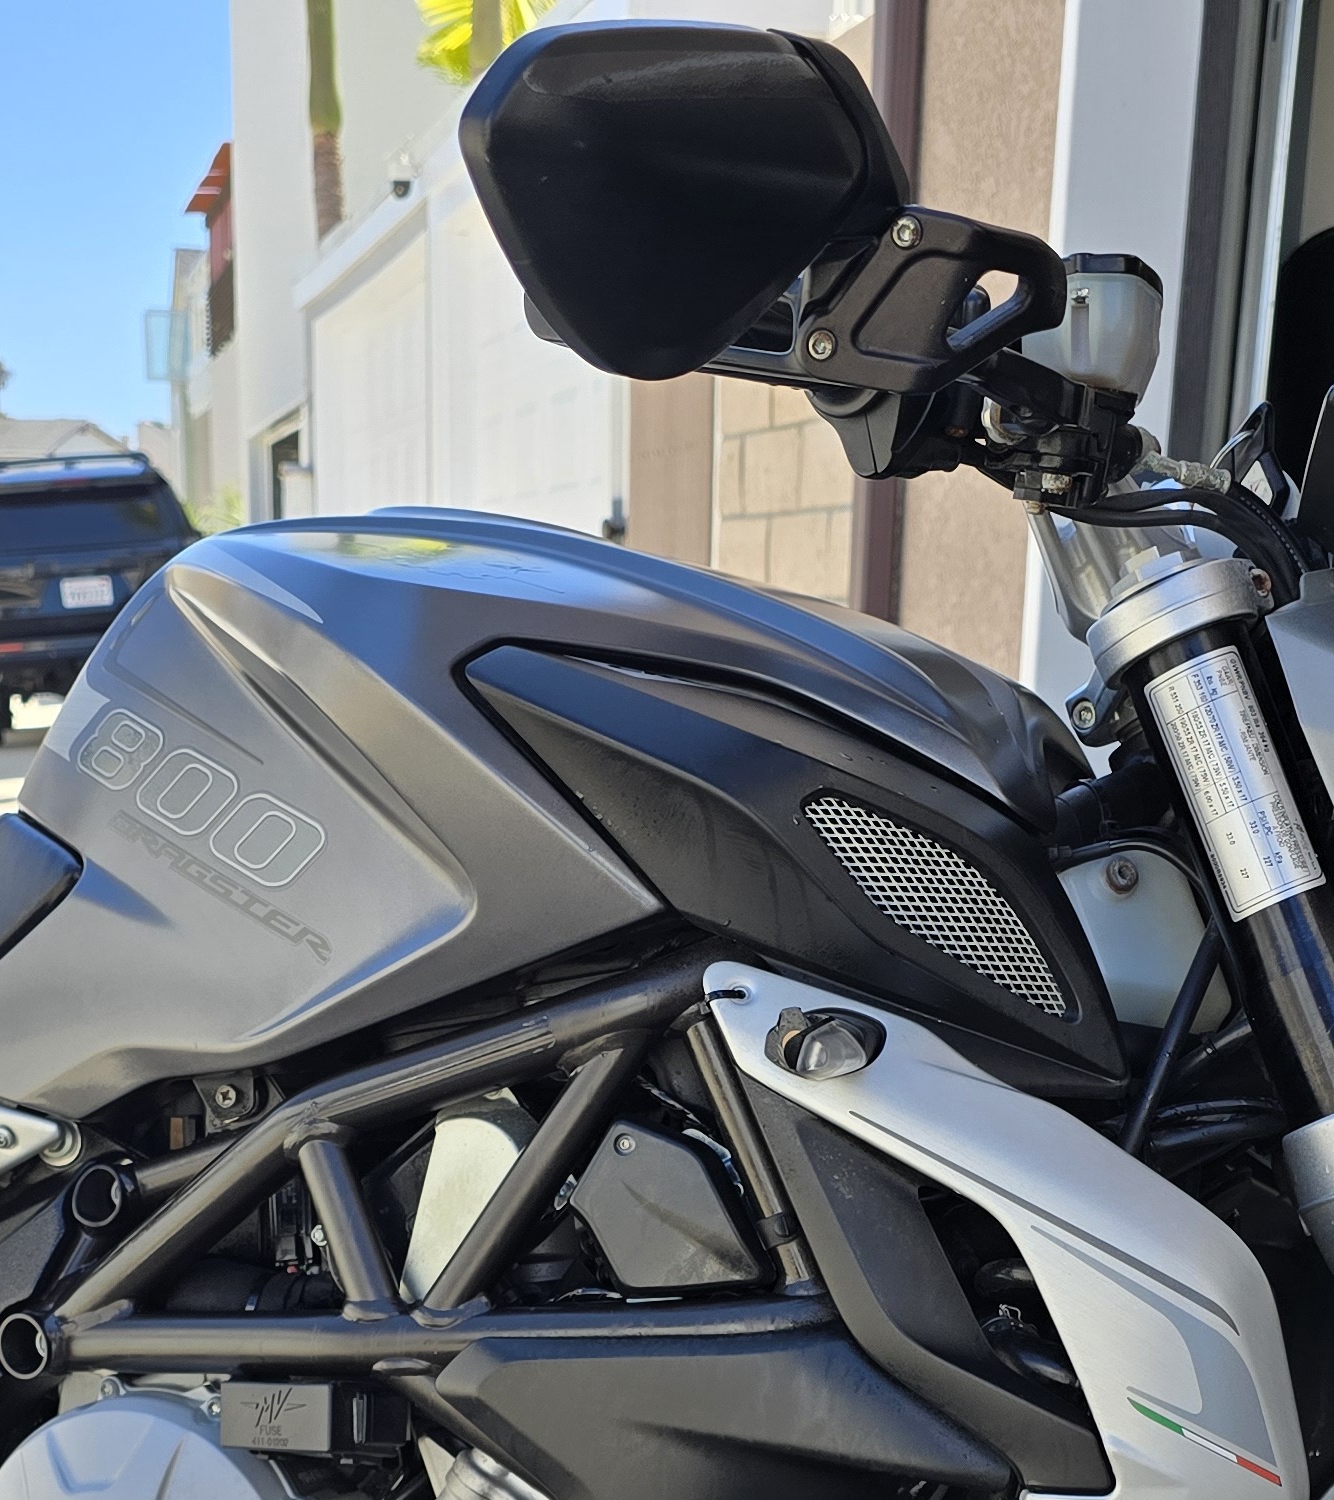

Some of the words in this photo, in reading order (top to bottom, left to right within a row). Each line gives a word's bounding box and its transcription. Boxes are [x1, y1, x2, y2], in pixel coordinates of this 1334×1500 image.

[78, 708, 326, 888] 800
[108, 810, 334, 965] DRAGSTER
[259, 1424, 283, 1438] FUSE
